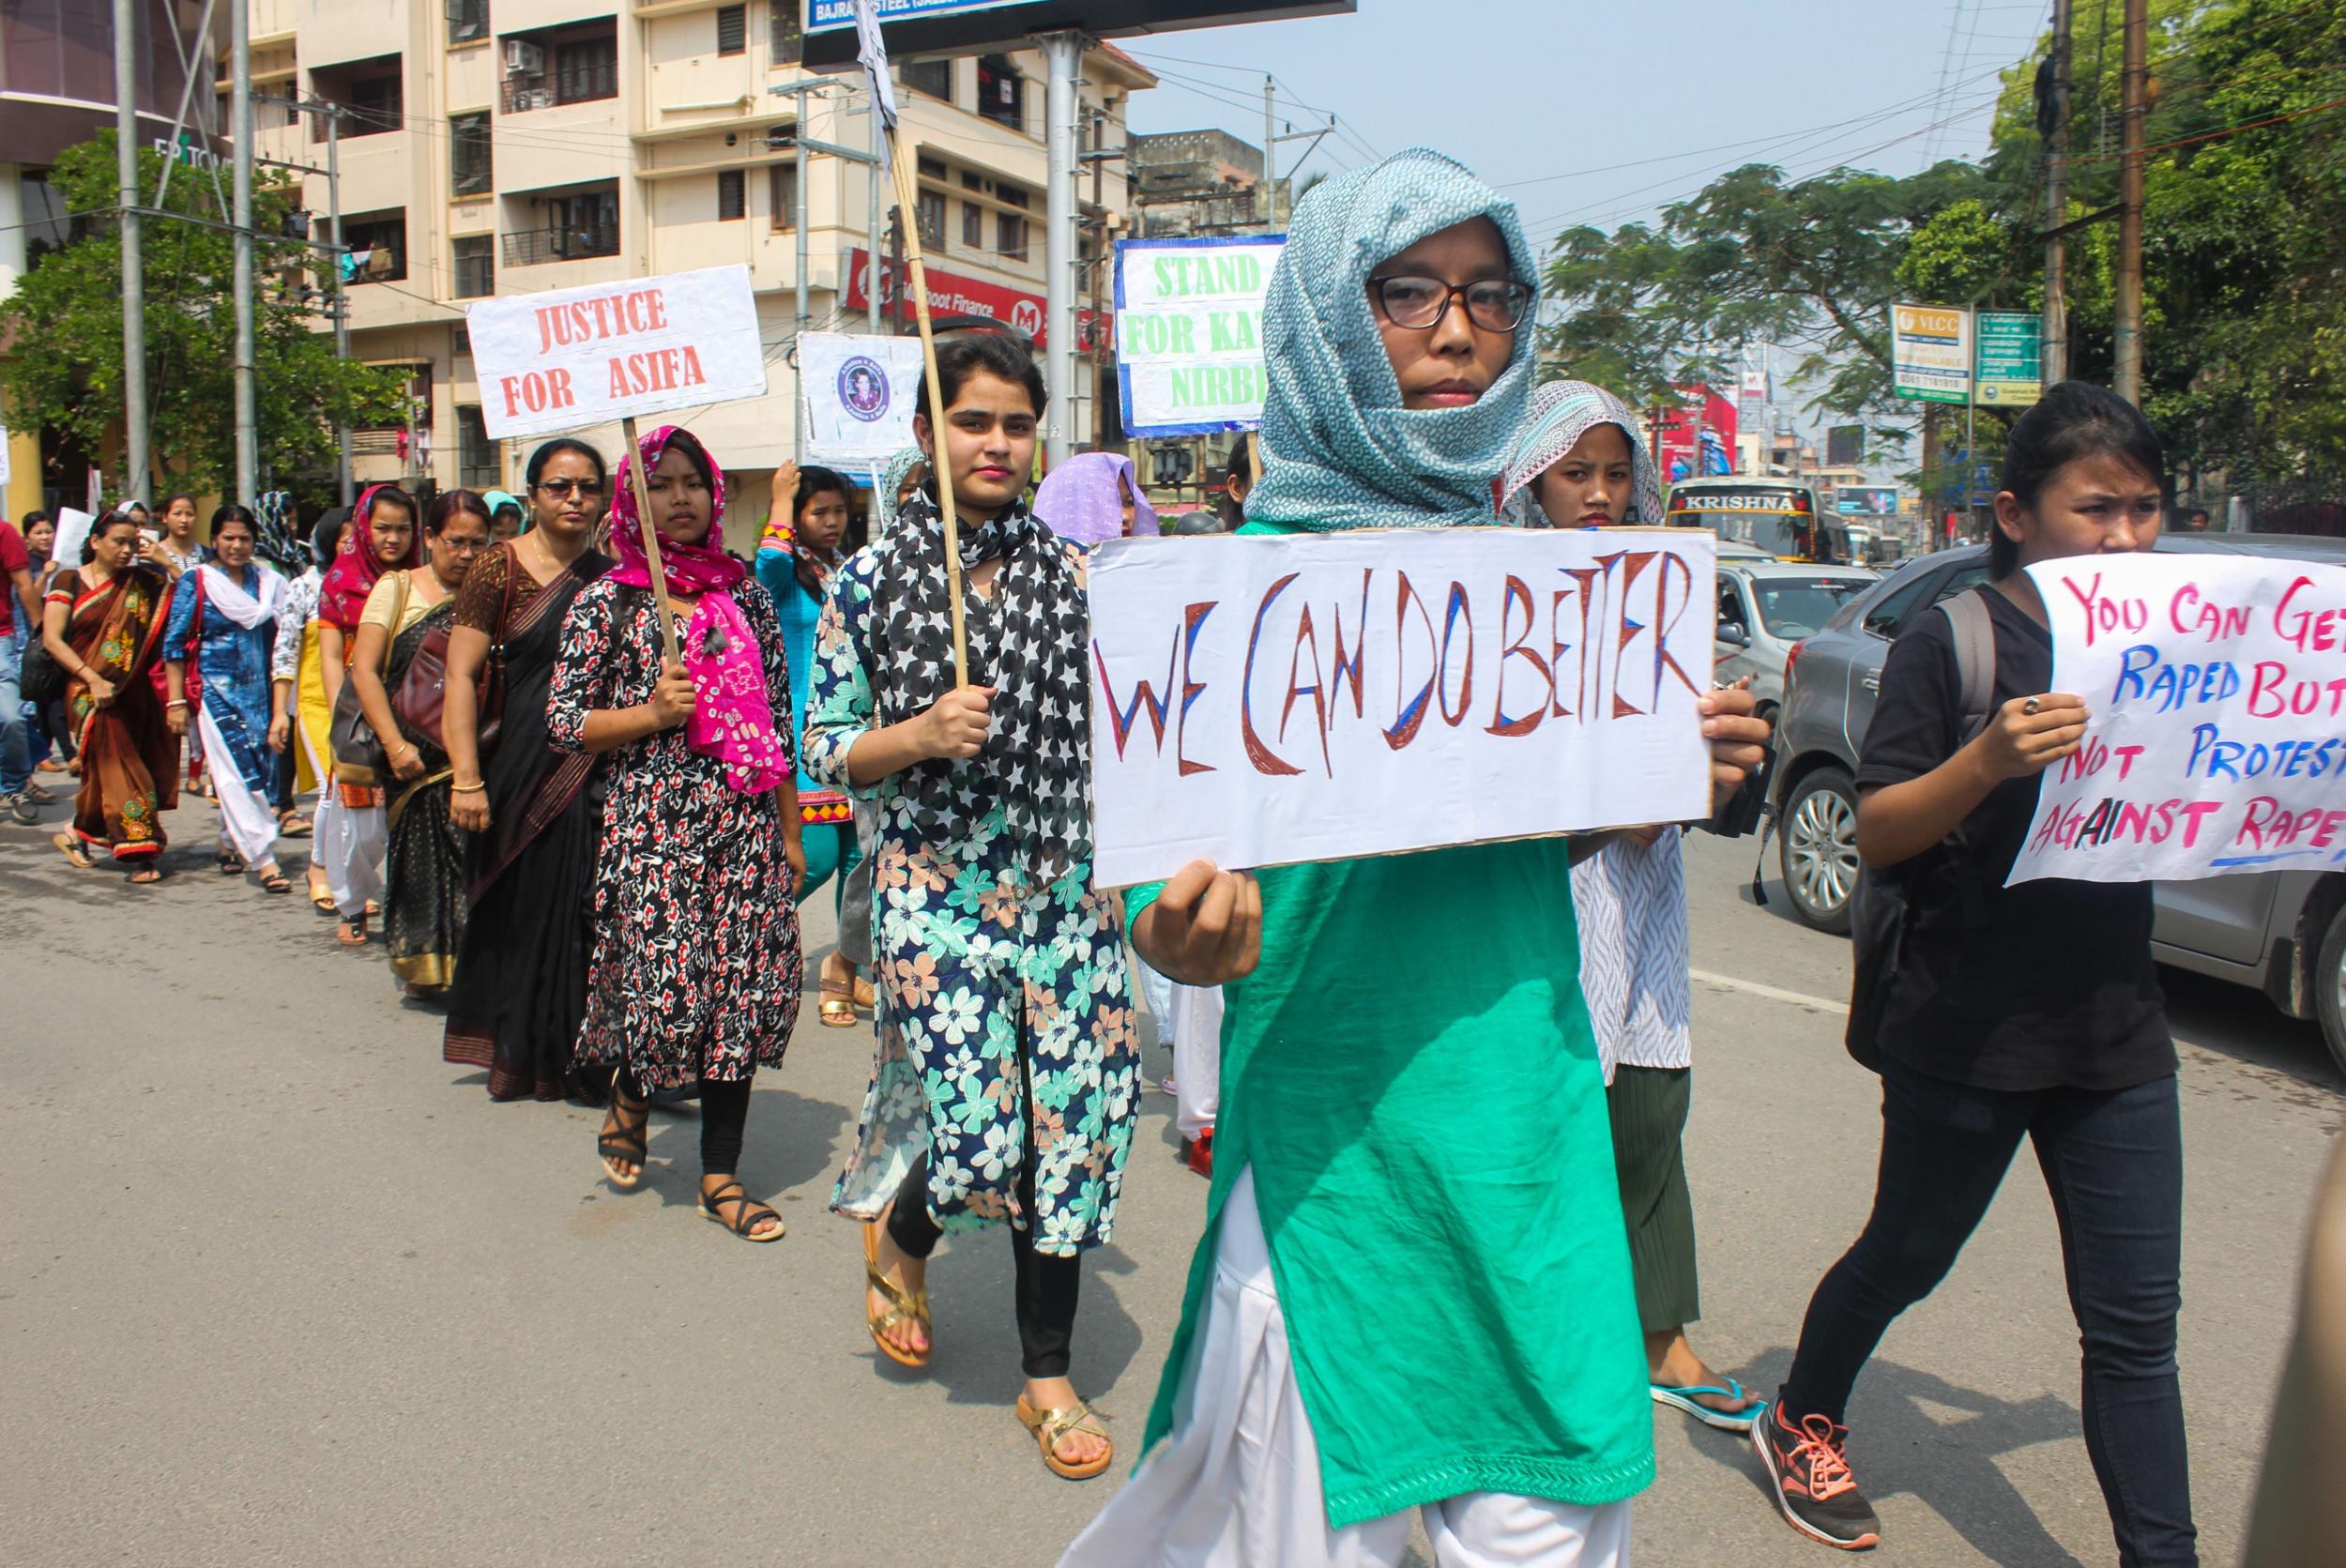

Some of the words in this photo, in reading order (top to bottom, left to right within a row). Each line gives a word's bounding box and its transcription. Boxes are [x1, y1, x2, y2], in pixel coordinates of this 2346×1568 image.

[1154, 254, 1261, 297] STAND
[534, 288, 668, 356] JUSTICE
[952, 293, 995, 317] Finance
[1919, 314, 1958, 332] VLCC
[1124, 313, 1196, 356] FOR
[499, 368, 575, 419] FOR
[608, 344, 707, 399] ASIFA
[1685, 495, 1795, 511] KRISHNA
[2061, 571, 2149, 647] YOU
[2170, 581, 2253, 643] CAN
[1092, 601, 1220, 778] WE
[1242, 568, 1374, 780] CAN
[1381, 569, 1473, 751] DO
[1484, 549, 1702, 737] BETTER
[2111, 644, 2241, 714] RAPED
[2247, 661, 2346, 719] BUT
[2059, 735, 2145, 785] NOT
[2029, 797, 2223, 857] AGAINST
[2236, 796, 2346, 851] RAPE
